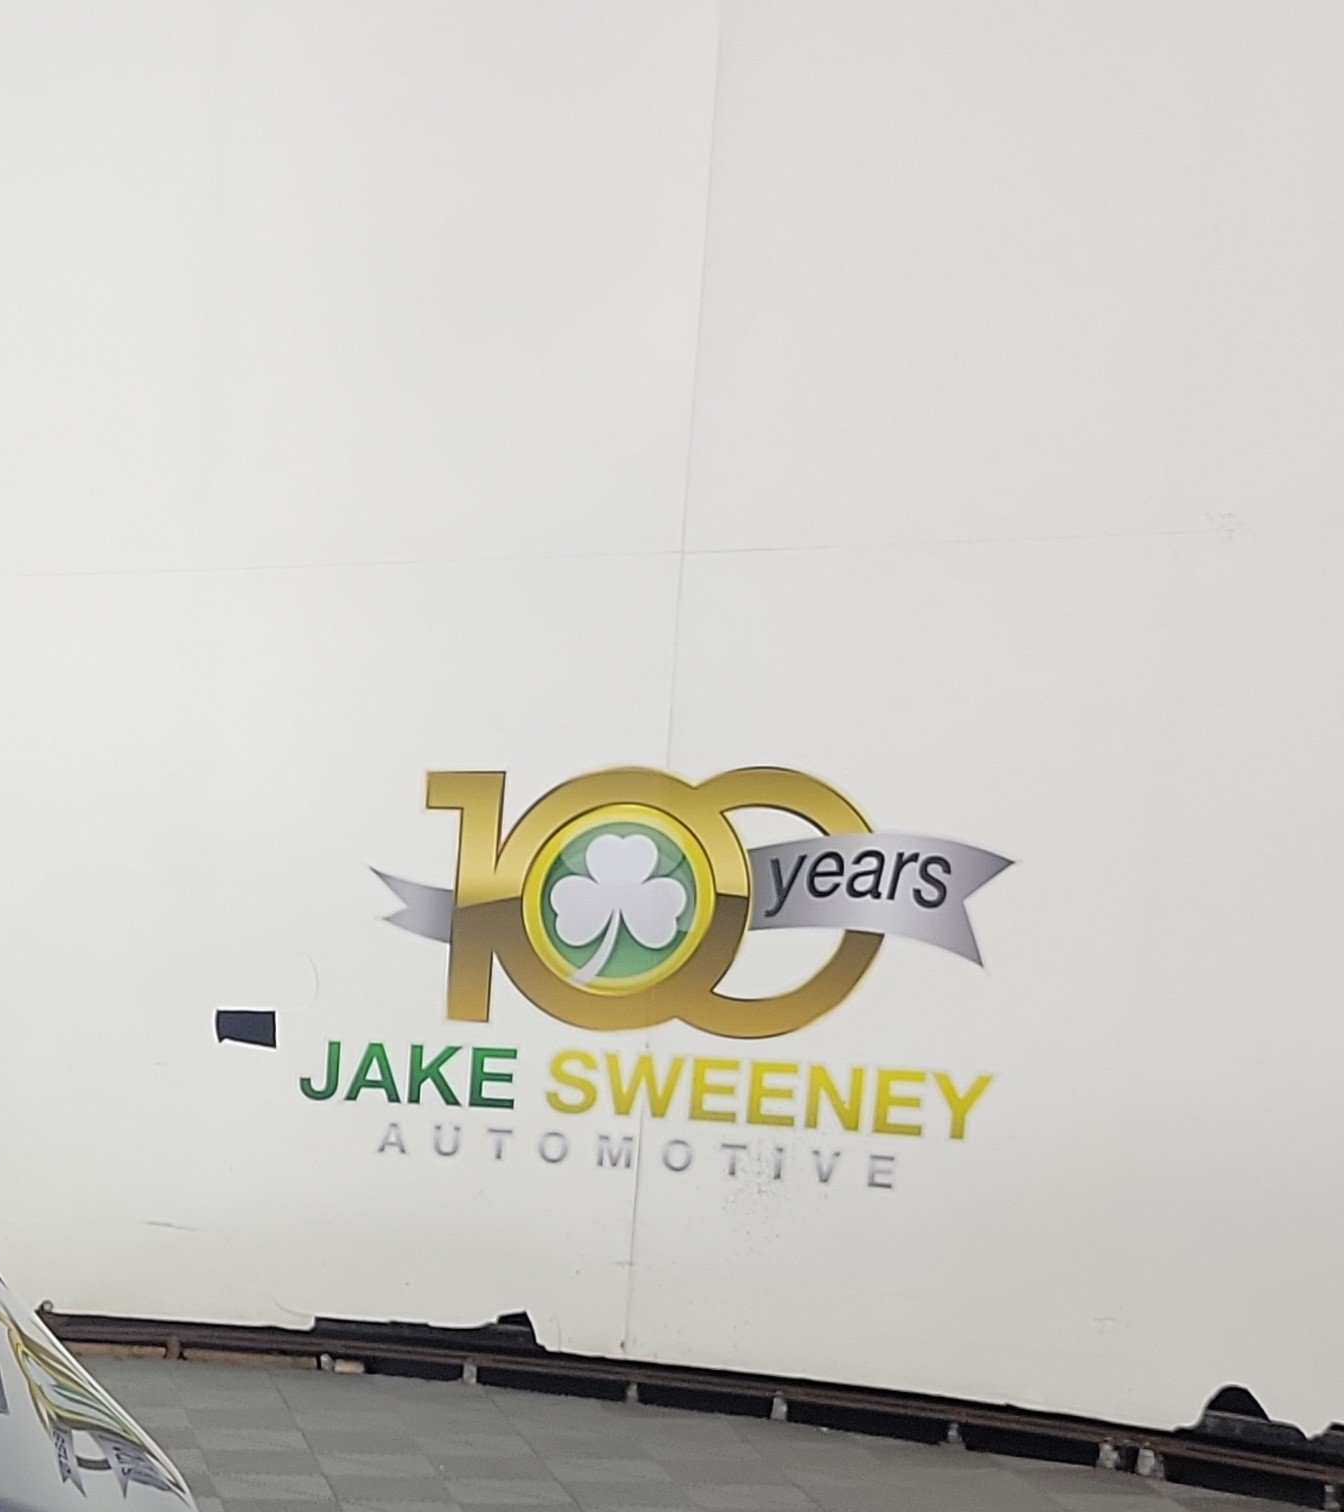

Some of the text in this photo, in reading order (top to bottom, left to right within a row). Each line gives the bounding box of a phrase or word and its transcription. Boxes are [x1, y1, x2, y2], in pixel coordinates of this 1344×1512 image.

[425, 766, 953, 1039] 100 years
[299, 1041, 993, 1140] JAKE SWEENEY
[378, 1123, 895, 1190] AUTOMOTIVE
